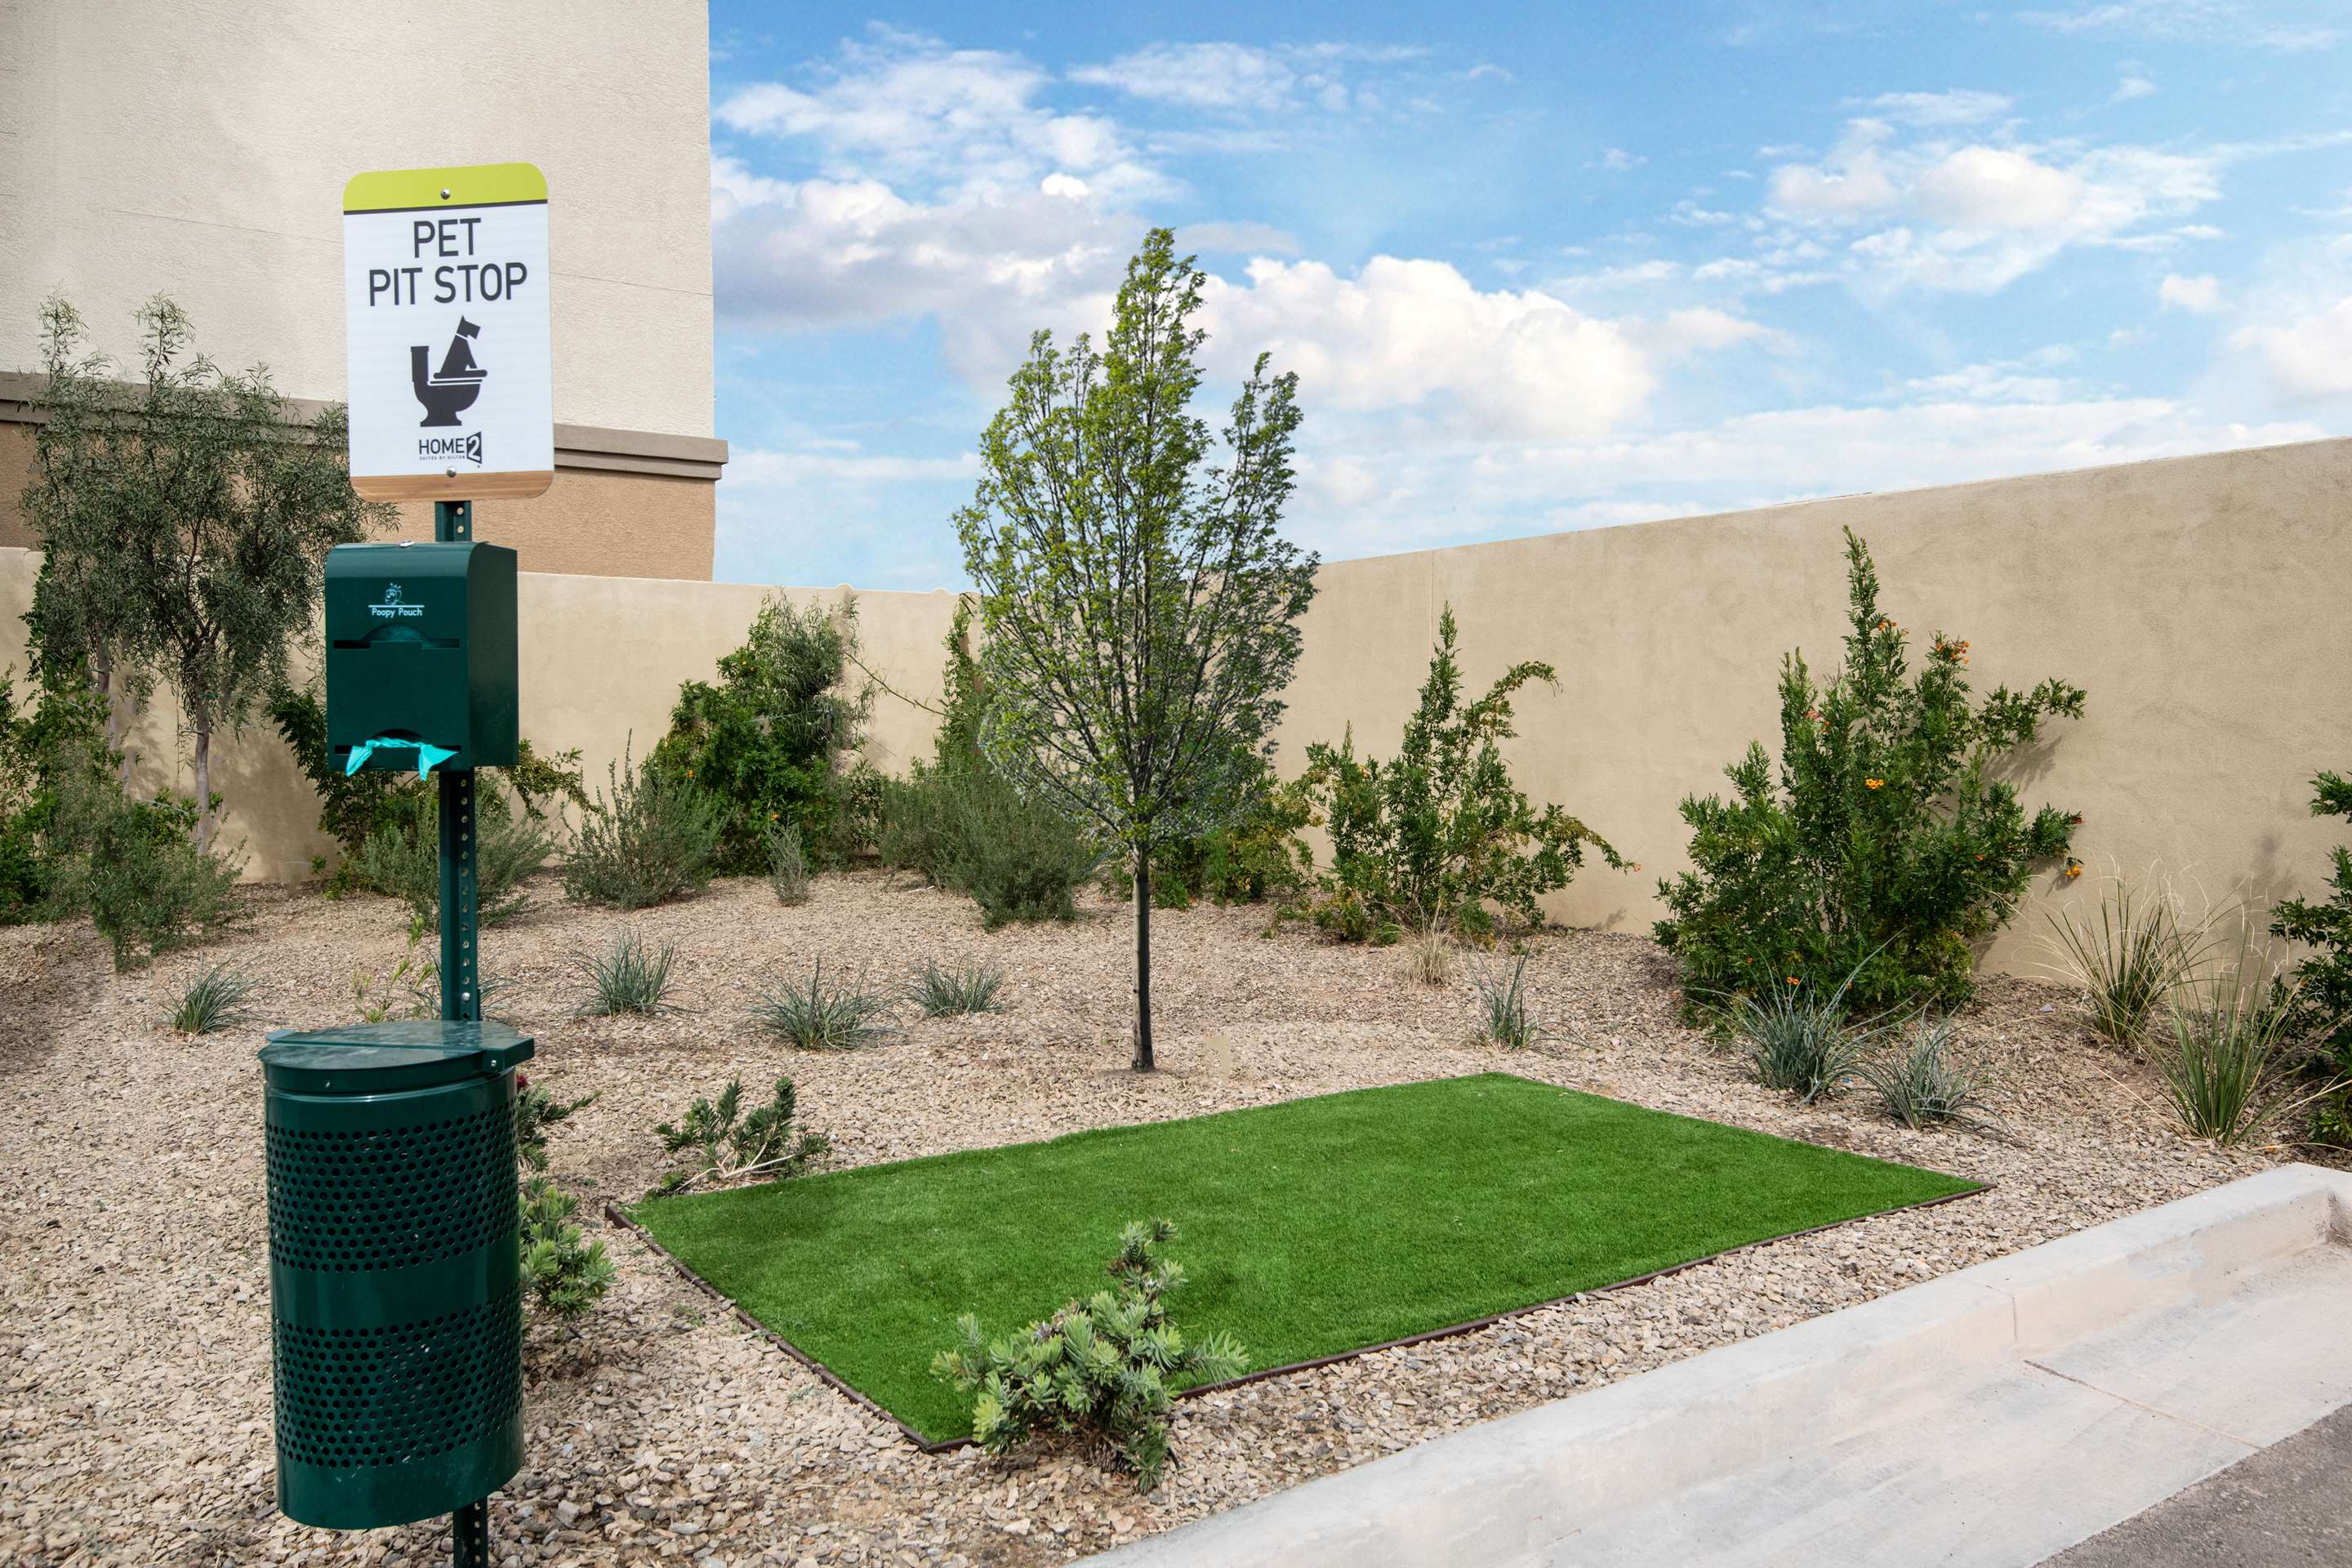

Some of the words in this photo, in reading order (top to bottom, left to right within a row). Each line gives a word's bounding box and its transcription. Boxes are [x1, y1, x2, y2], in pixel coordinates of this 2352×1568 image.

[413, 217, 482, 259] PET
[369, 267, 423, 307] PIT
[434, 261, 528, 304] STOP
[372, 608, 395, 618] Poopy
[398, 608, 422, 616] Pouch
